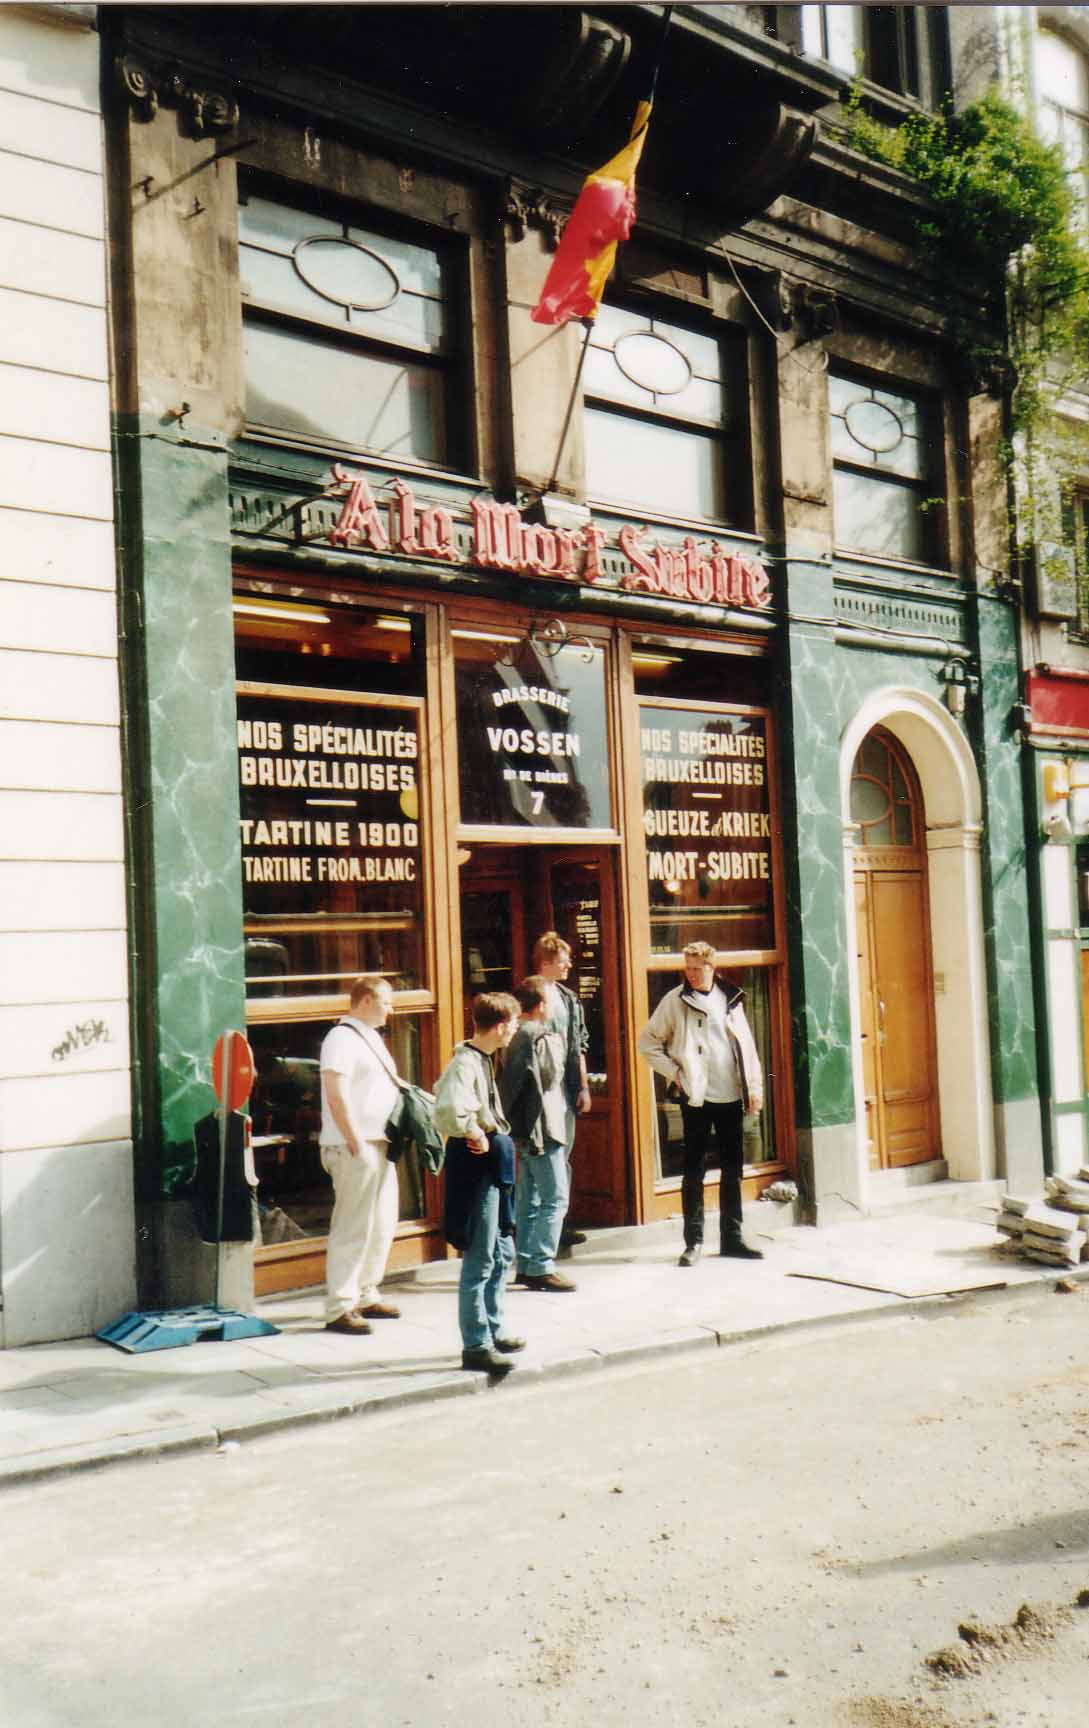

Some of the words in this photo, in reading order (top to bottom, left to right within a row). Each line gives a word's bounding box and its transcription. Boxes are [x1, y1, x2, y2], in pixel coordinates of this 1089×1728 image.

[392, 476, 466, 562] la
[469, 496, 607, 584] Mort
[619, 525, 773, 608] Subite
[491, 686, 572, 713] BRASSERIE
[237, 720, 283, 750] NOS
[293, 721, 418, 759] SPÉCIALITÉS
[486, 727, 581, 757] VOSSEN
[640, 728, 672, 753] NOS
[240, 756, 415, 791] BRUXELLOISES
[644, 758, 764, 786] BRUXELLOISES
[530, 791, 545, 815] 7
[239, 819, 351, 847] TARTINE
[358, 822, 419, 848] 1900
[643, 809, 710, 837] GUEUZE
[722, 811, 770, 838] KRIEK
[242, 856, 313, 883] TARTINE
